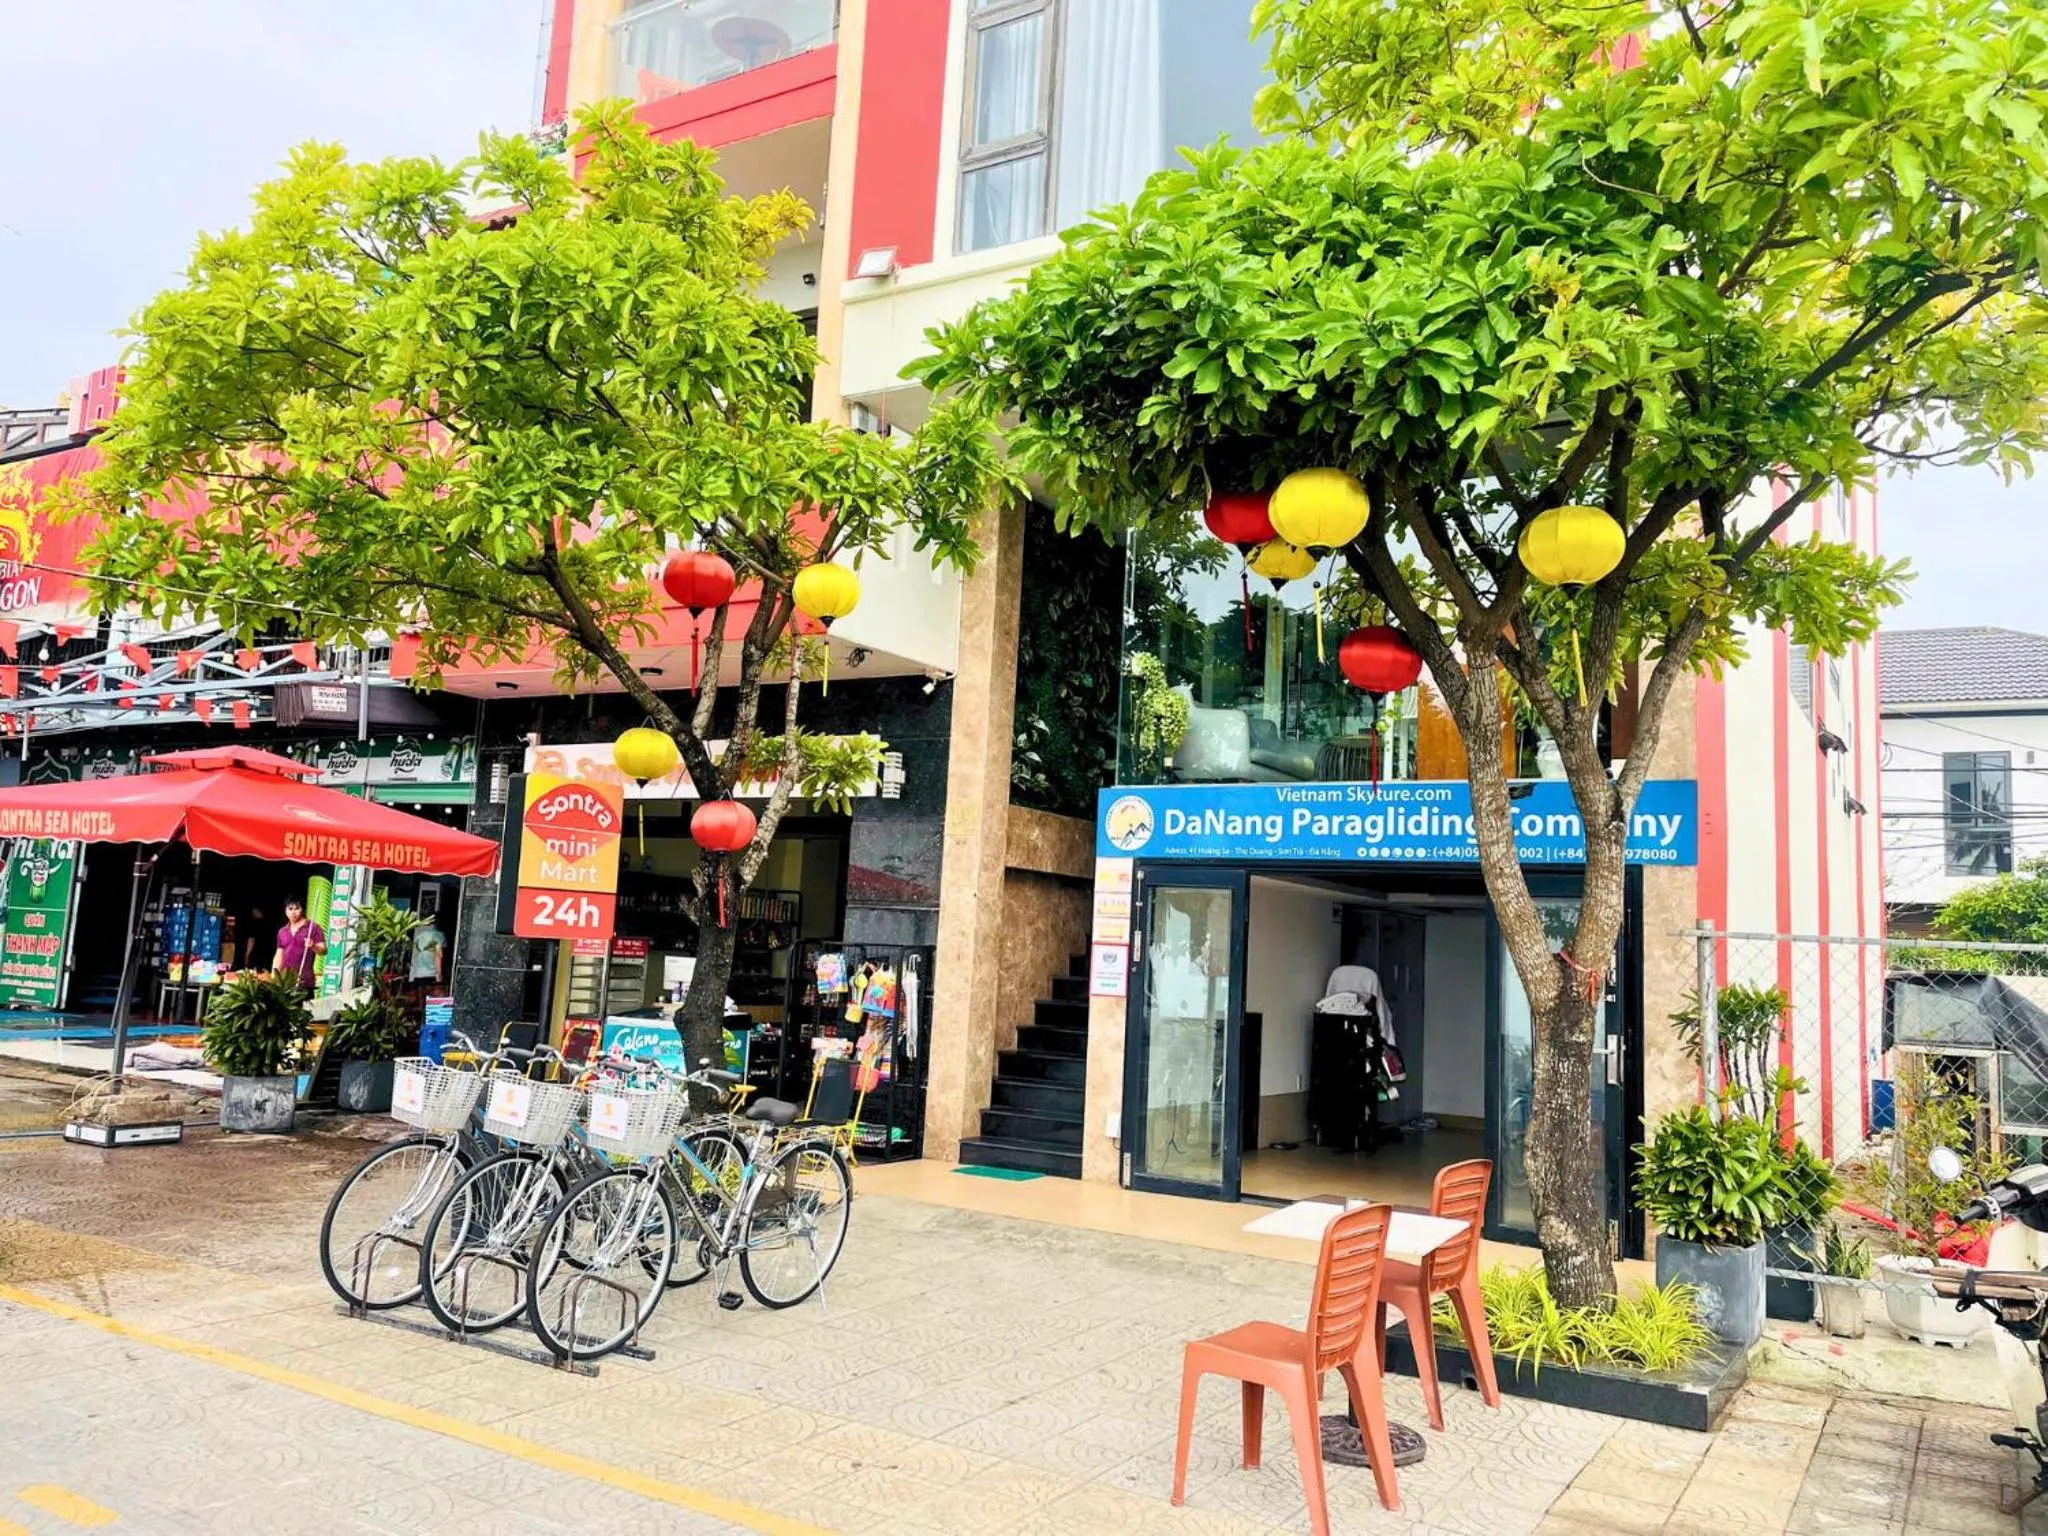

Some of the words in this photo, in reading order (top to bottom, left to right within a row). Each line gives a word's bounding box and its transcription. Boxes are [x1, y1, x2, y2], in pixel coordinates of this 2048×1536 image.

[538, 793, 613, 829] Sontra
[1276, 787, 1343, 802] Vietnam
[1346, 786, 1452, 806] Skyture.com
[0, 808, 43, 833] ONTRA
[44, 810, 69, 834] SEA
[71, 811, 116, 836] HOTEL
[1164, 808, 1284, 843] DaNang
[283, 832, 349, 861] SONTRA
[352, 839, 381, 863] SEA
[384, 844, 431, 867] HOTEL
[546, 834, 597, 857] mini
[540, 861, 599, 884] Mart
[533, 895, 600, 928] 24h
